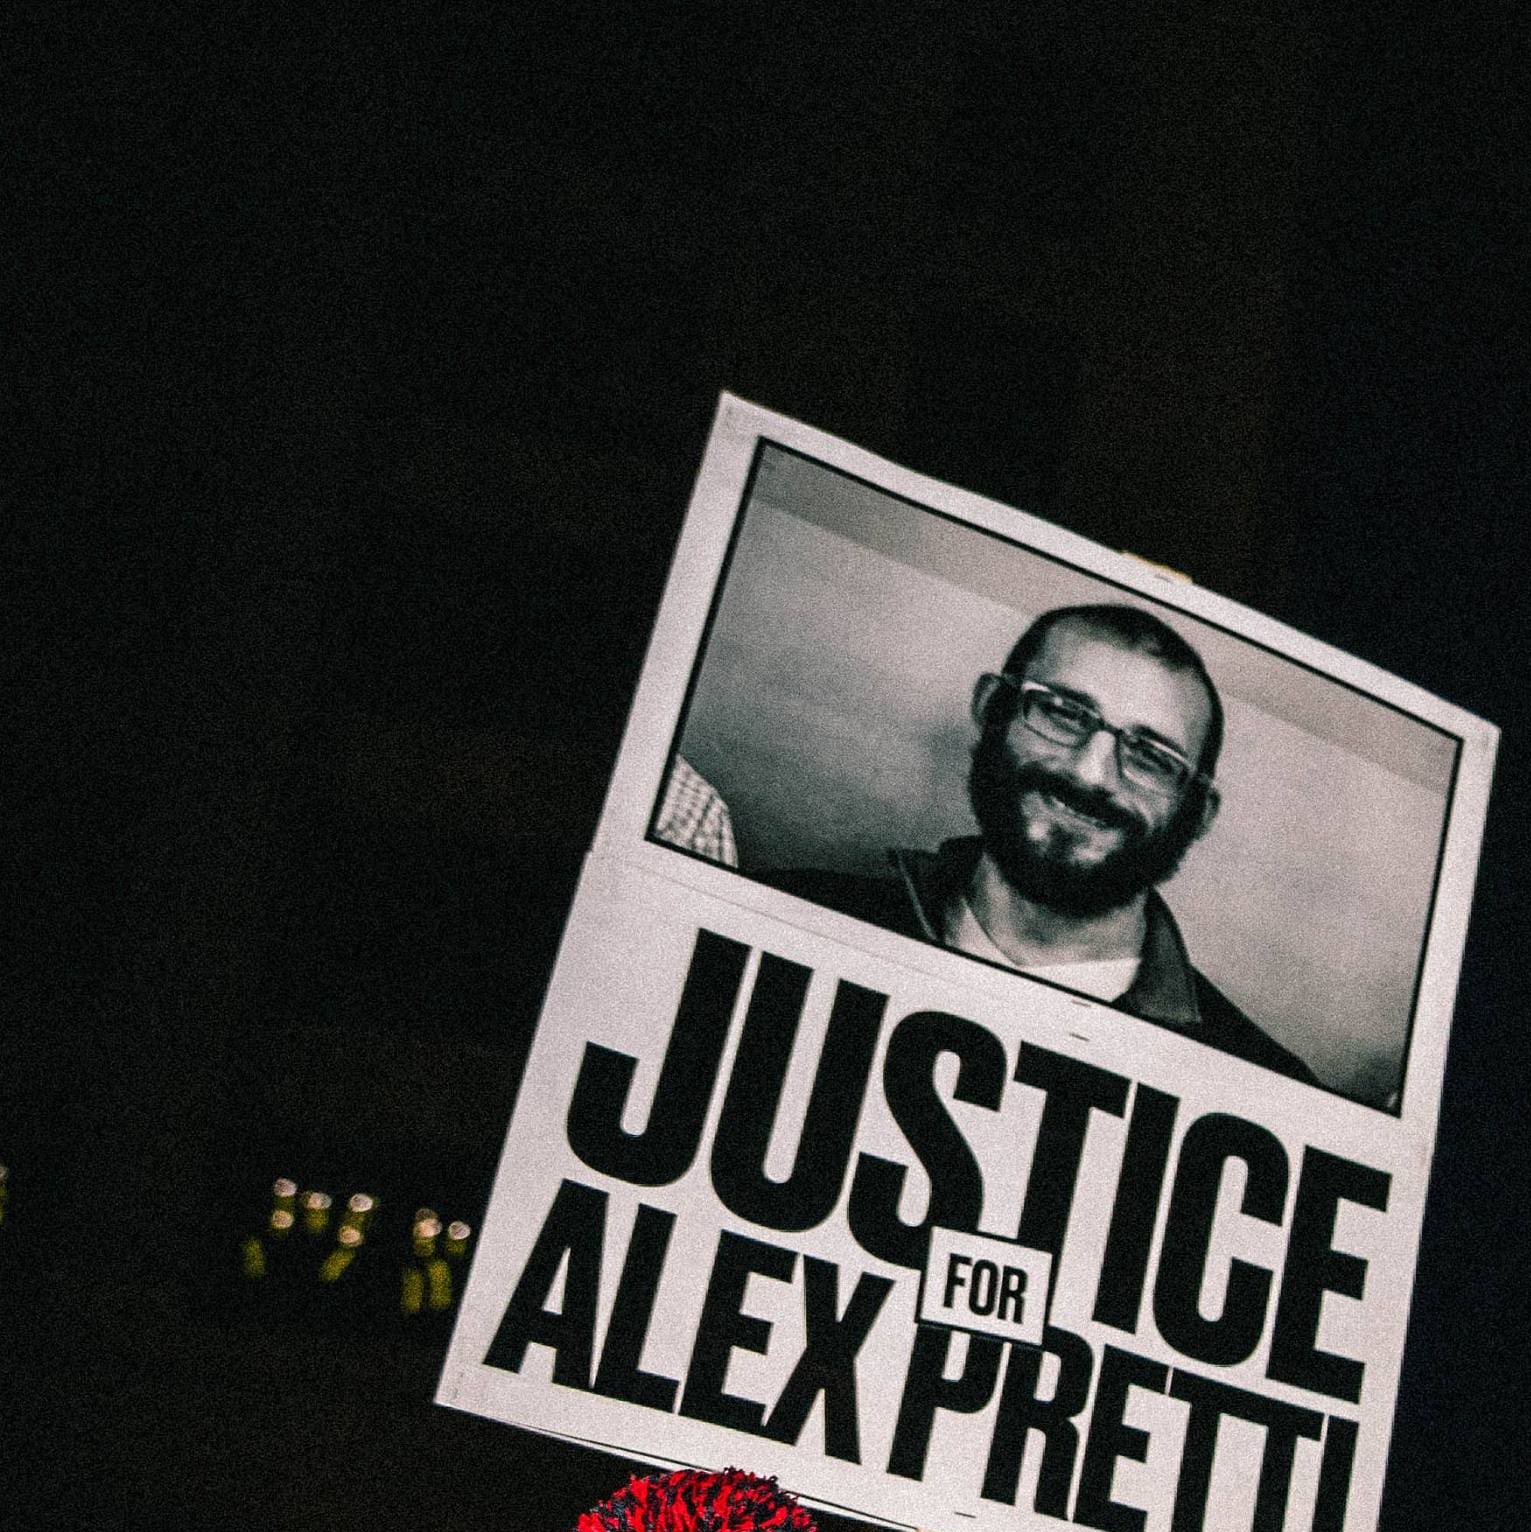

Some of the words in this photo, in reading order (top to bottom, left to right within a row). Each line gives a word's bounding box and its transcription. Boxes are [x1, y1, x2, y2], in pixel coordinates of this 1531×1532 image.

[565, 927, 1392, 1404] JUSTICE
[940, 1252, 1029, 1326] FOR
[483, 1178, 894, 1464] ALEX
